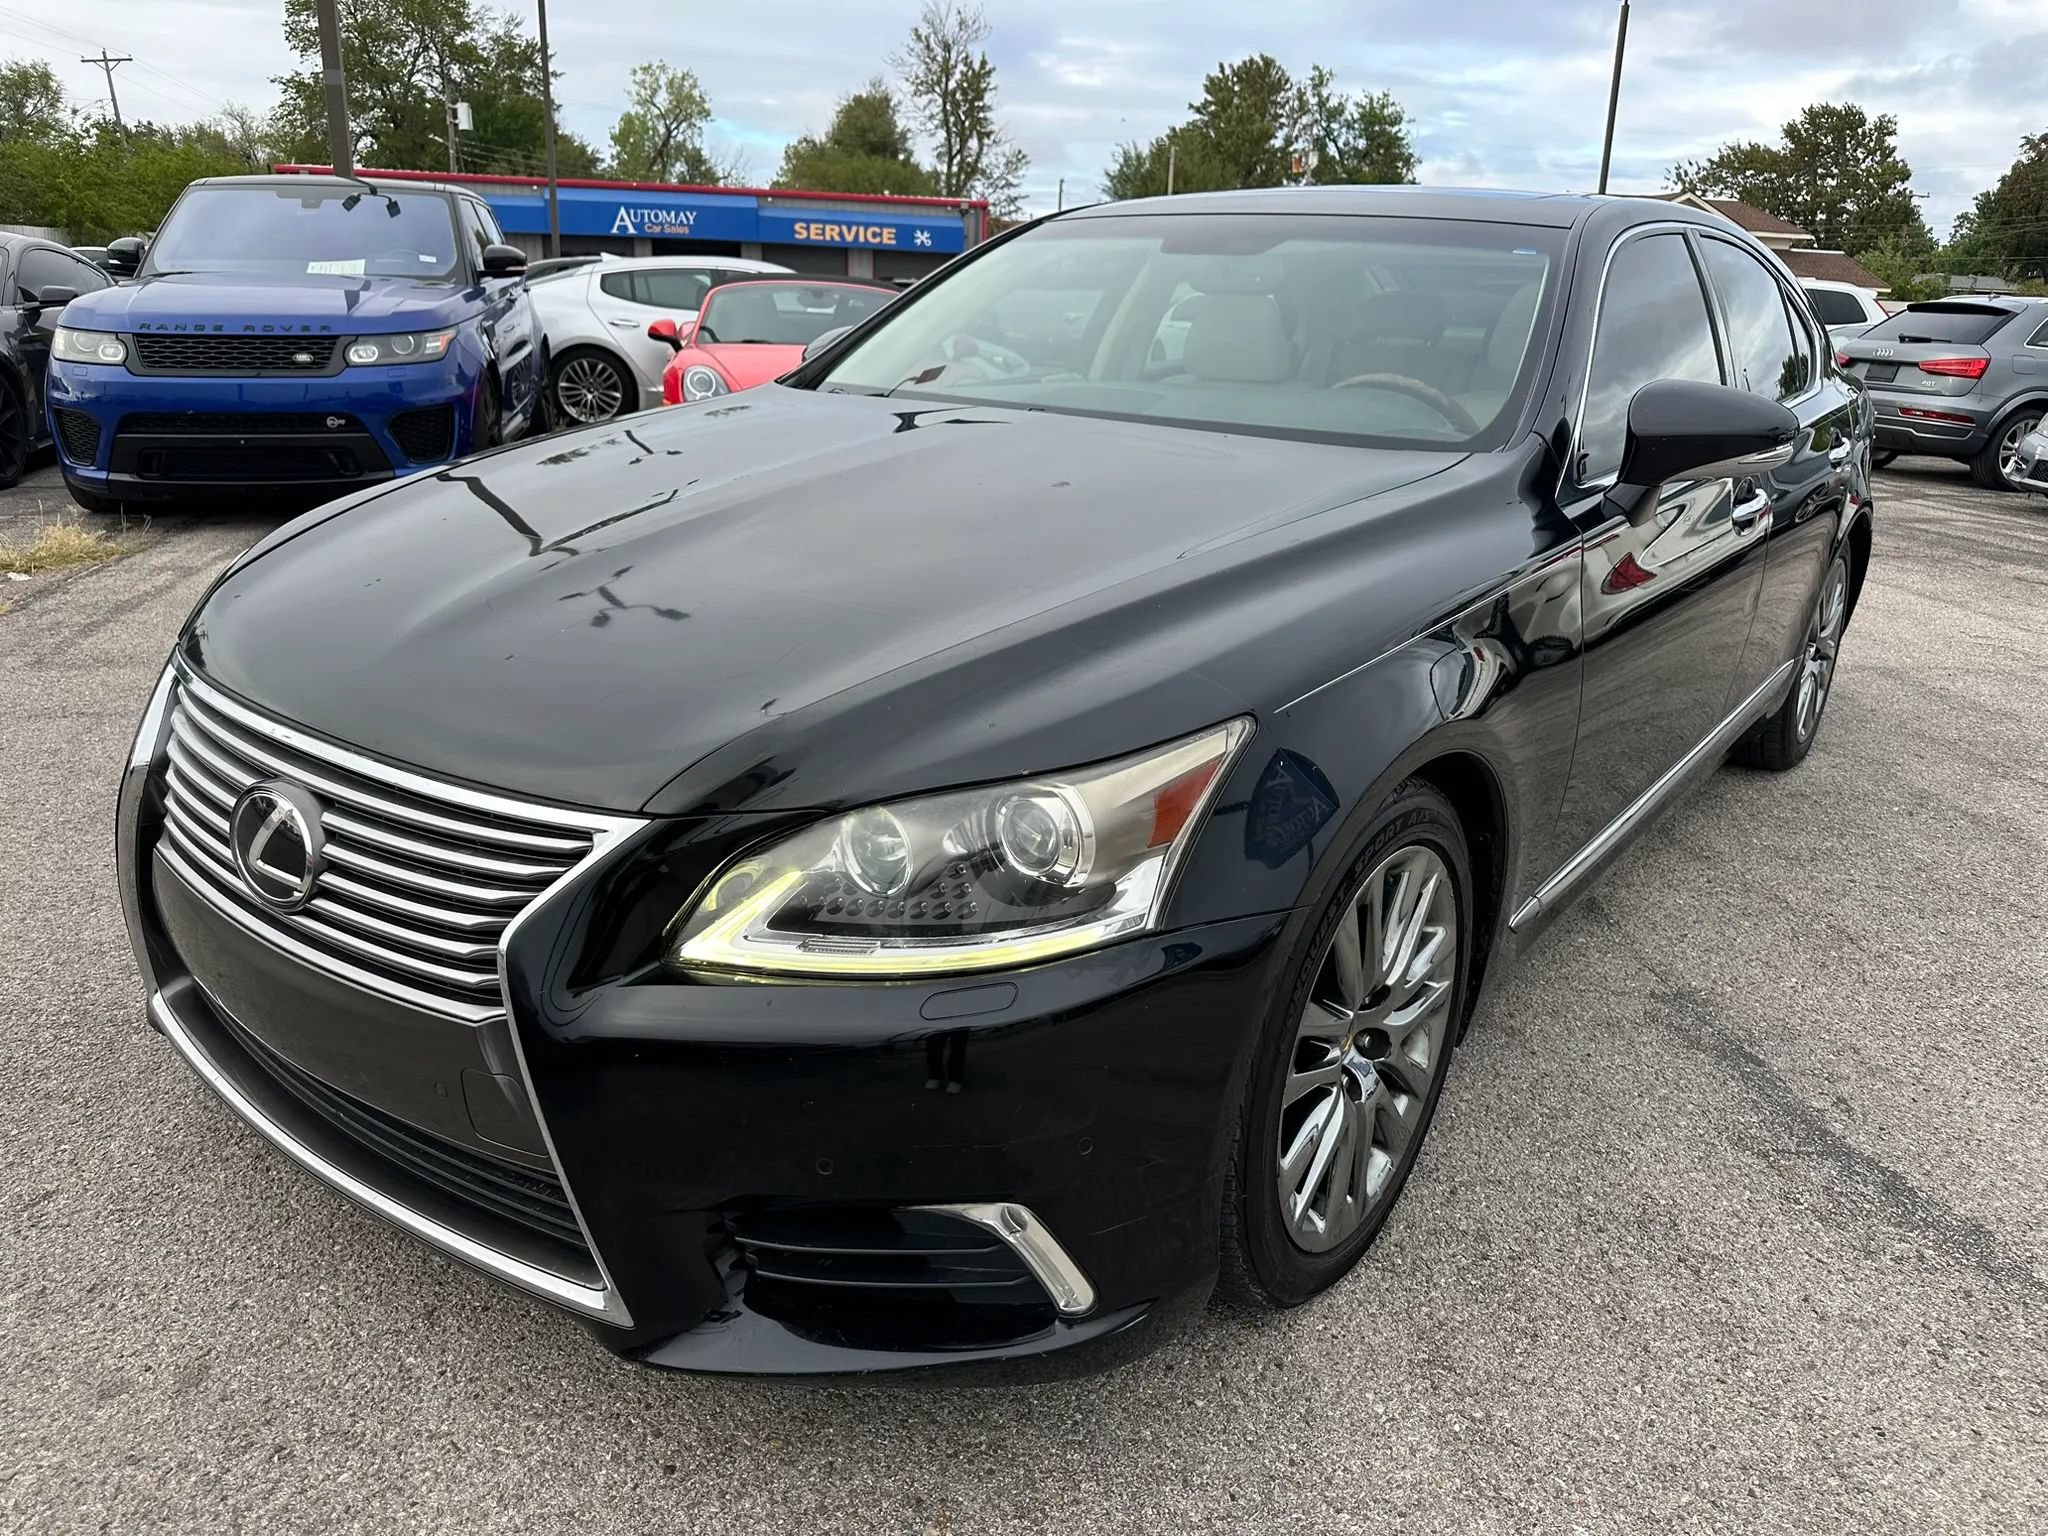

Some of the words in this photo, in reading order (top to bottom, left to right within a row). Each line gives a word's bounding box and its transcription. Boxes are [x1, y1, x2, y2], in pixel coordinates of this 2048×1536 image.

[610, 205, 697, 234] AUTOMAY
[644, 223, 662, 233] Car
[664, 224, 689, 234] Sales
[794, 222, 897, 245] SERVICE
[138, 322, 224, 332] RANGE
[243, 324, 332, 333] ROVER
[1353, 820, 1403, 874] SPORT
